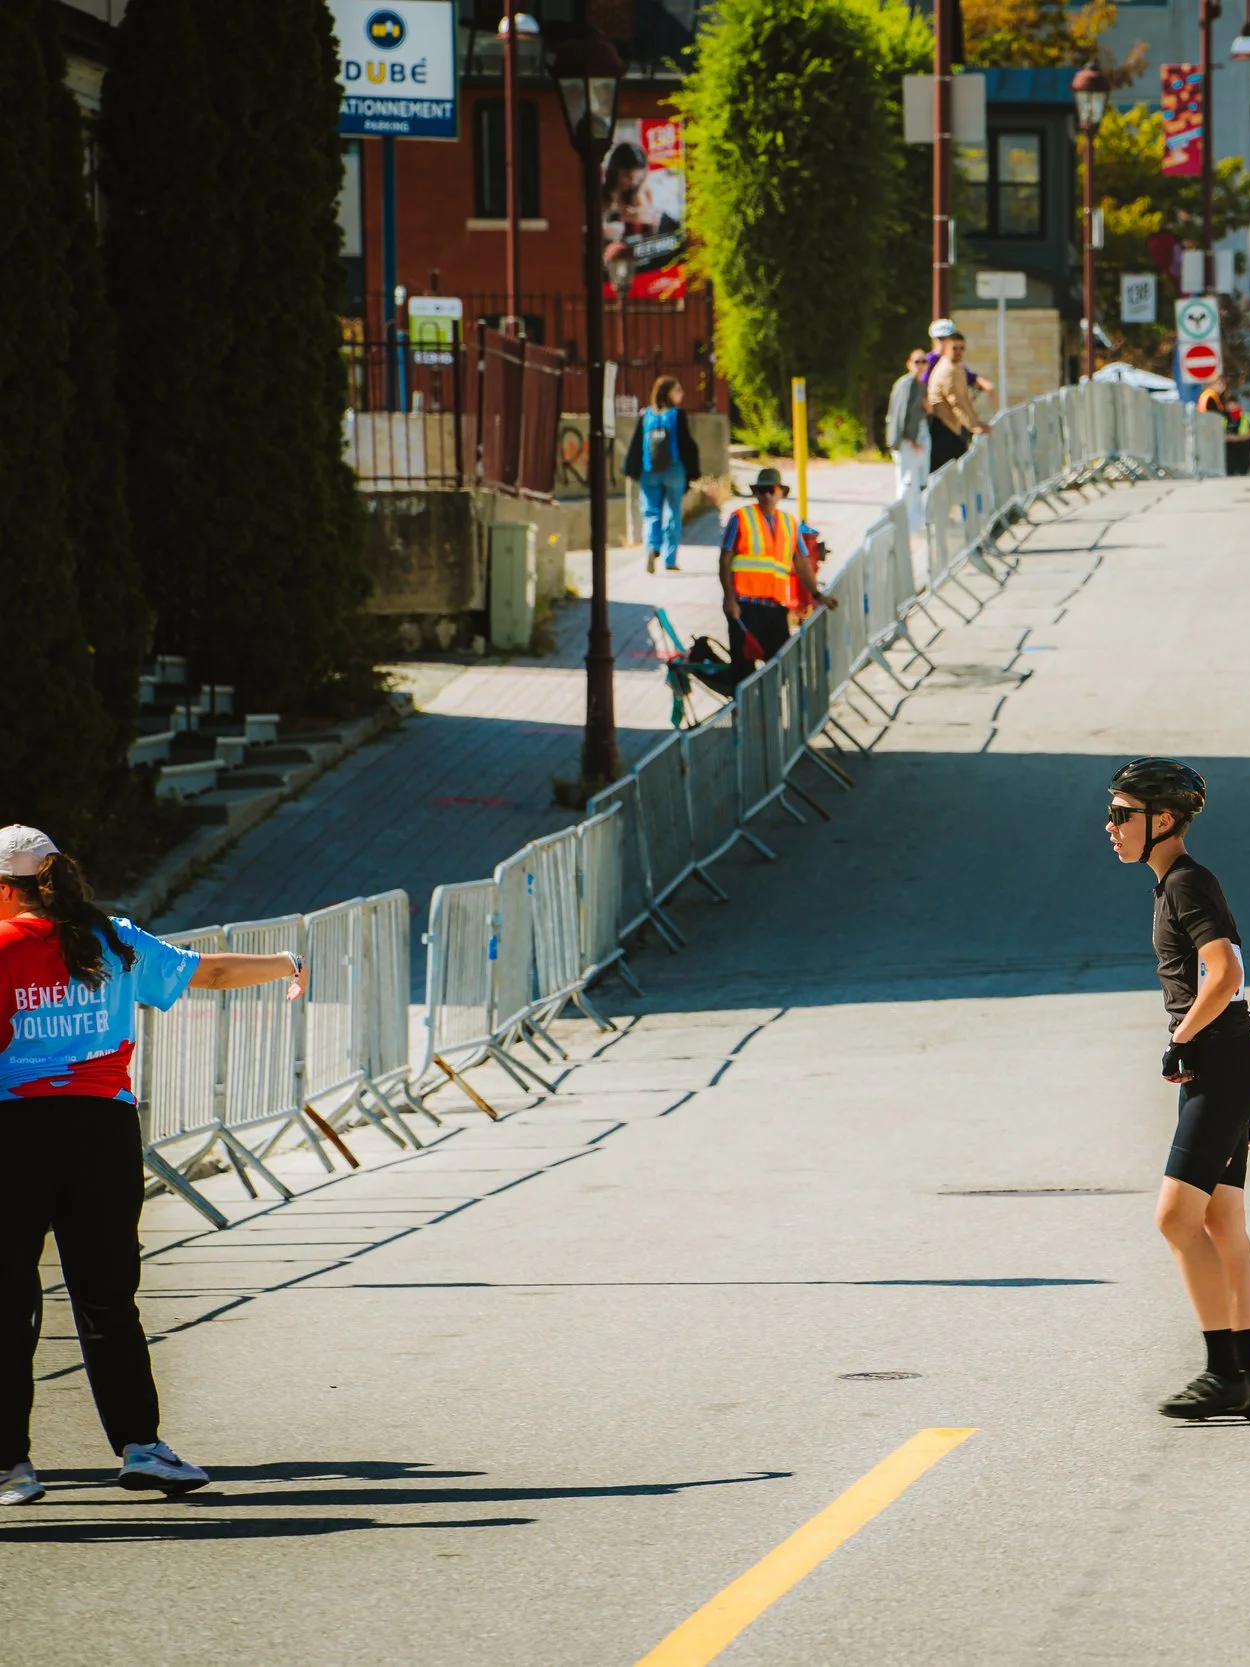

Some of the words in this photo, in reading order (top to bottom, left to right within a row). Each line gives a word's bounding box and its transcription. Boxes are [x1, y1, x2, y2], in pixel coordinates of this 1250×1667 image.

[344, 57, 427, 84] DUBÉ
[342, 99, 453, 118] ATIONNEMENT
[363, 119, 411, 132] PARKING
[15, 981, 106, 1010] BÉNÉVOLE
[12, 1009, 110, 1040] VOLUNTEER
[10, 1056, 46, 1064] Banque
